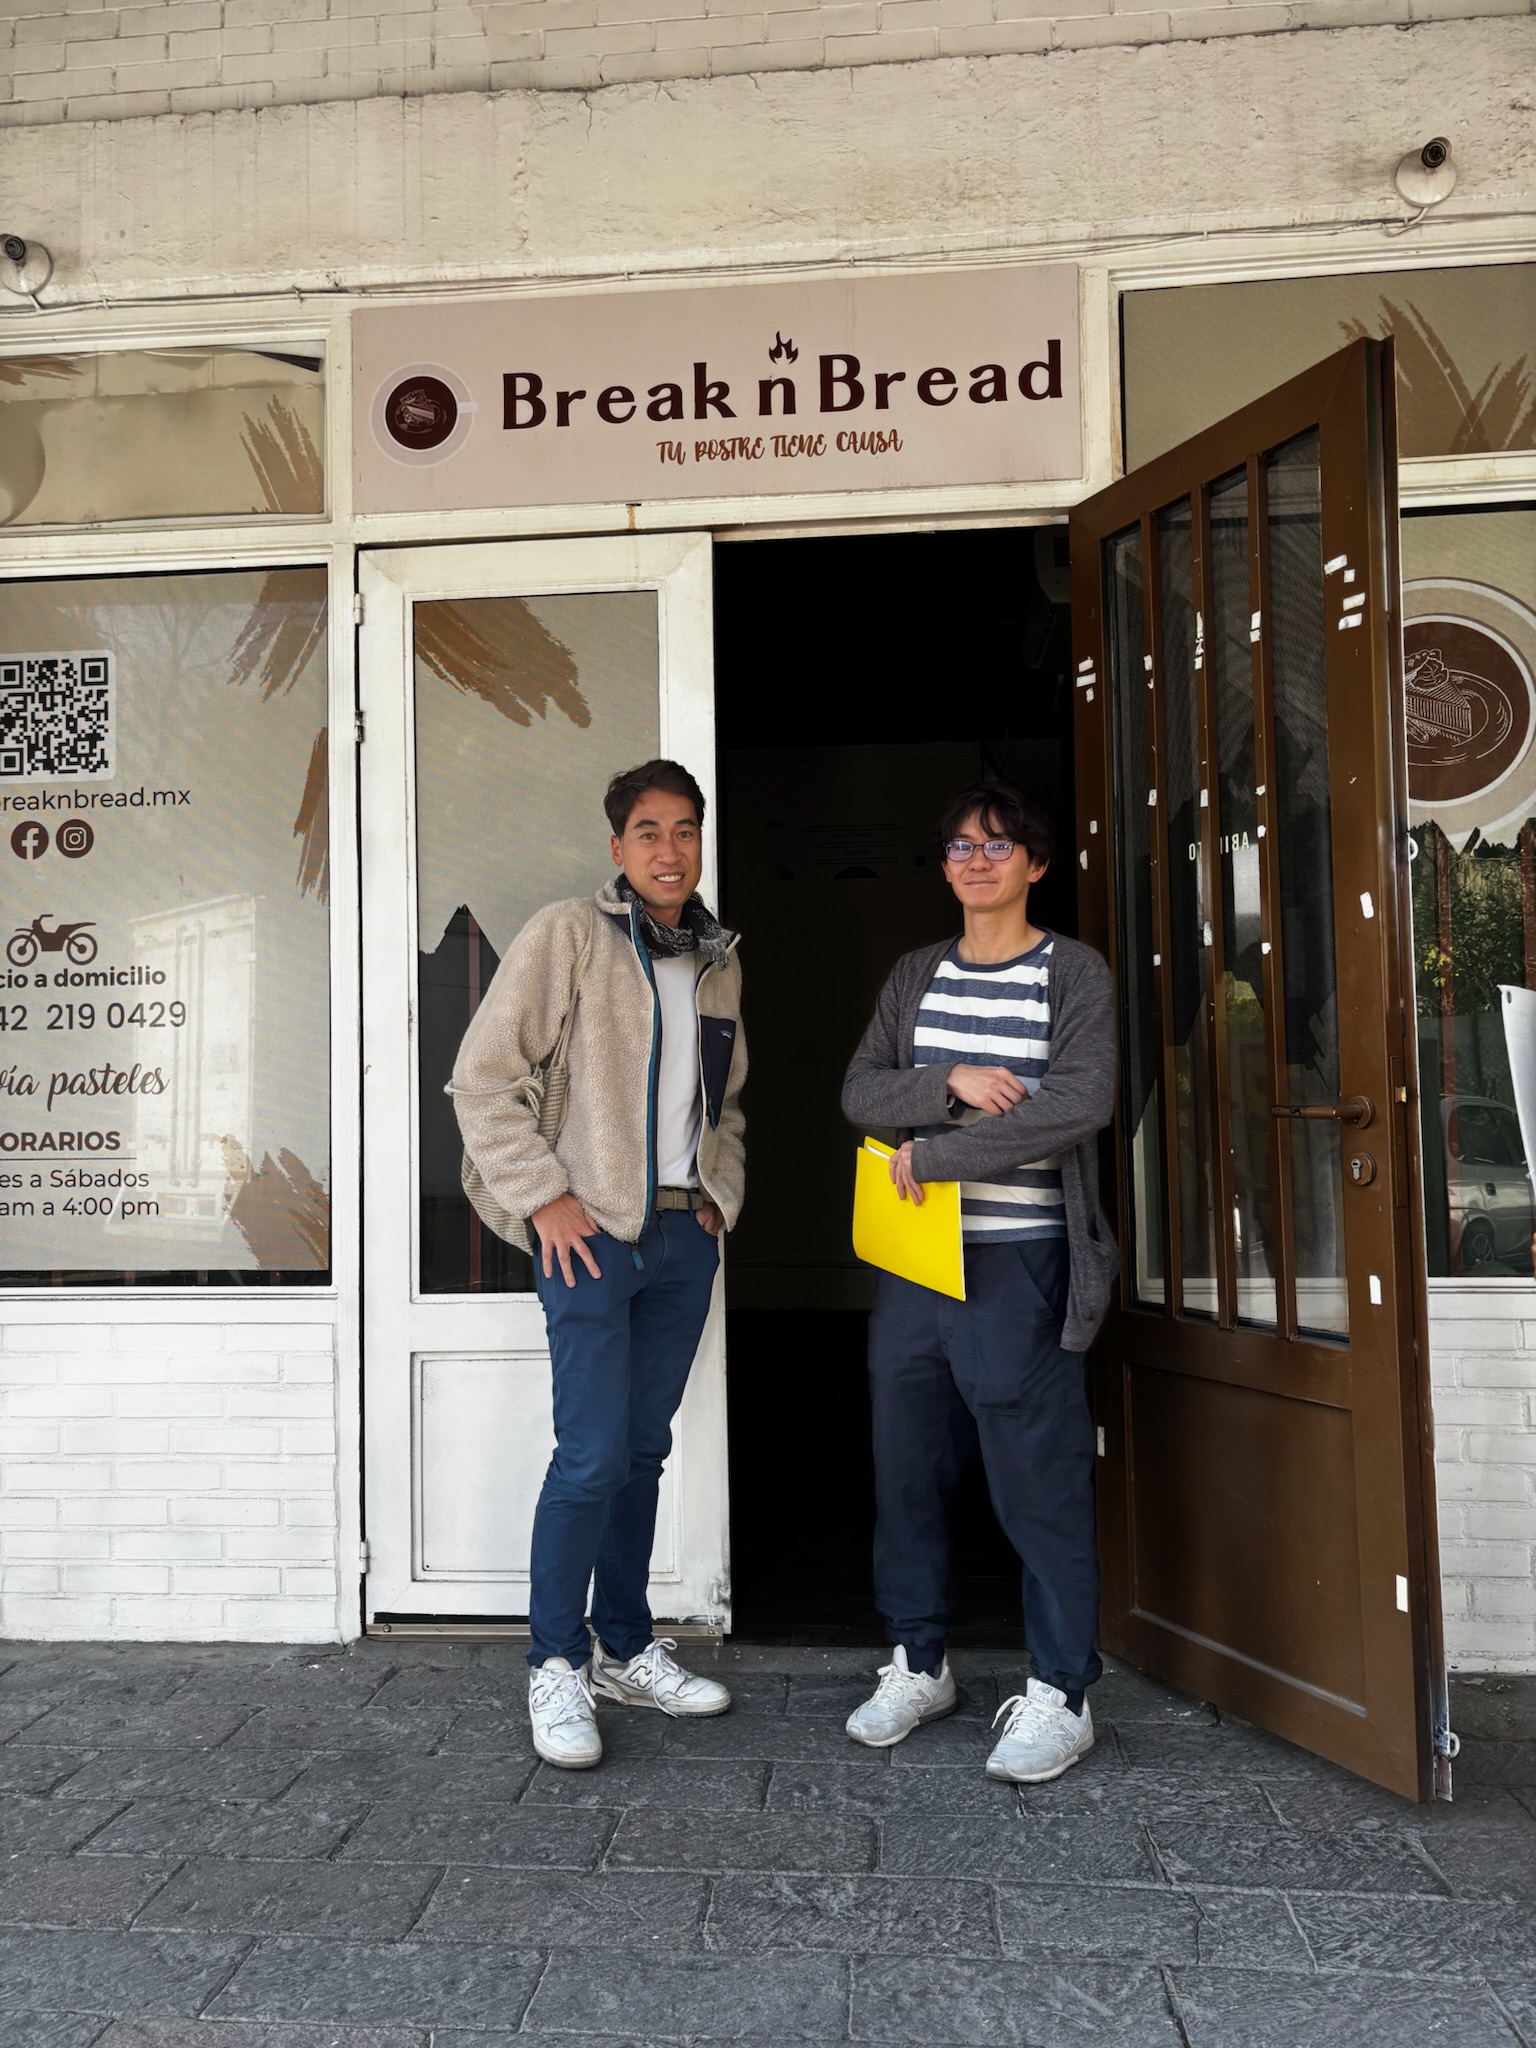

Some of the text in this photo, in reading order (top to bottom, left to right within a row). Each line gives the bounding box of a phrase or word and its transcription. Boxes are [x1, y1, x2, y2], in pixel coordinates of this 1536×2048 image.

[502, 338, 1063, 430] Break n Bread
[655, 428, 904, 466] TU POSTRE TIENE CAUSA
[0, 786, 191, 812] reaknbread.mx
[34, 973, 48, 988] a
[53, 965, 167, 988] domicilio
[46, 1003, 96, 1031] 219
[106, 1000, 187, 1029] 0429
[46, 1062, 171, 1112] pasteles
[0, 1130, 121, 1152] ORARIOS
[30, 1173, 42, 1188] a
[50, 1168, 149, 1189] Sábados
[42, 1201, 55, 1216] a
[62, 1196, 114, 1216] 4:00
[121, 1200, 160, 1220] pm
